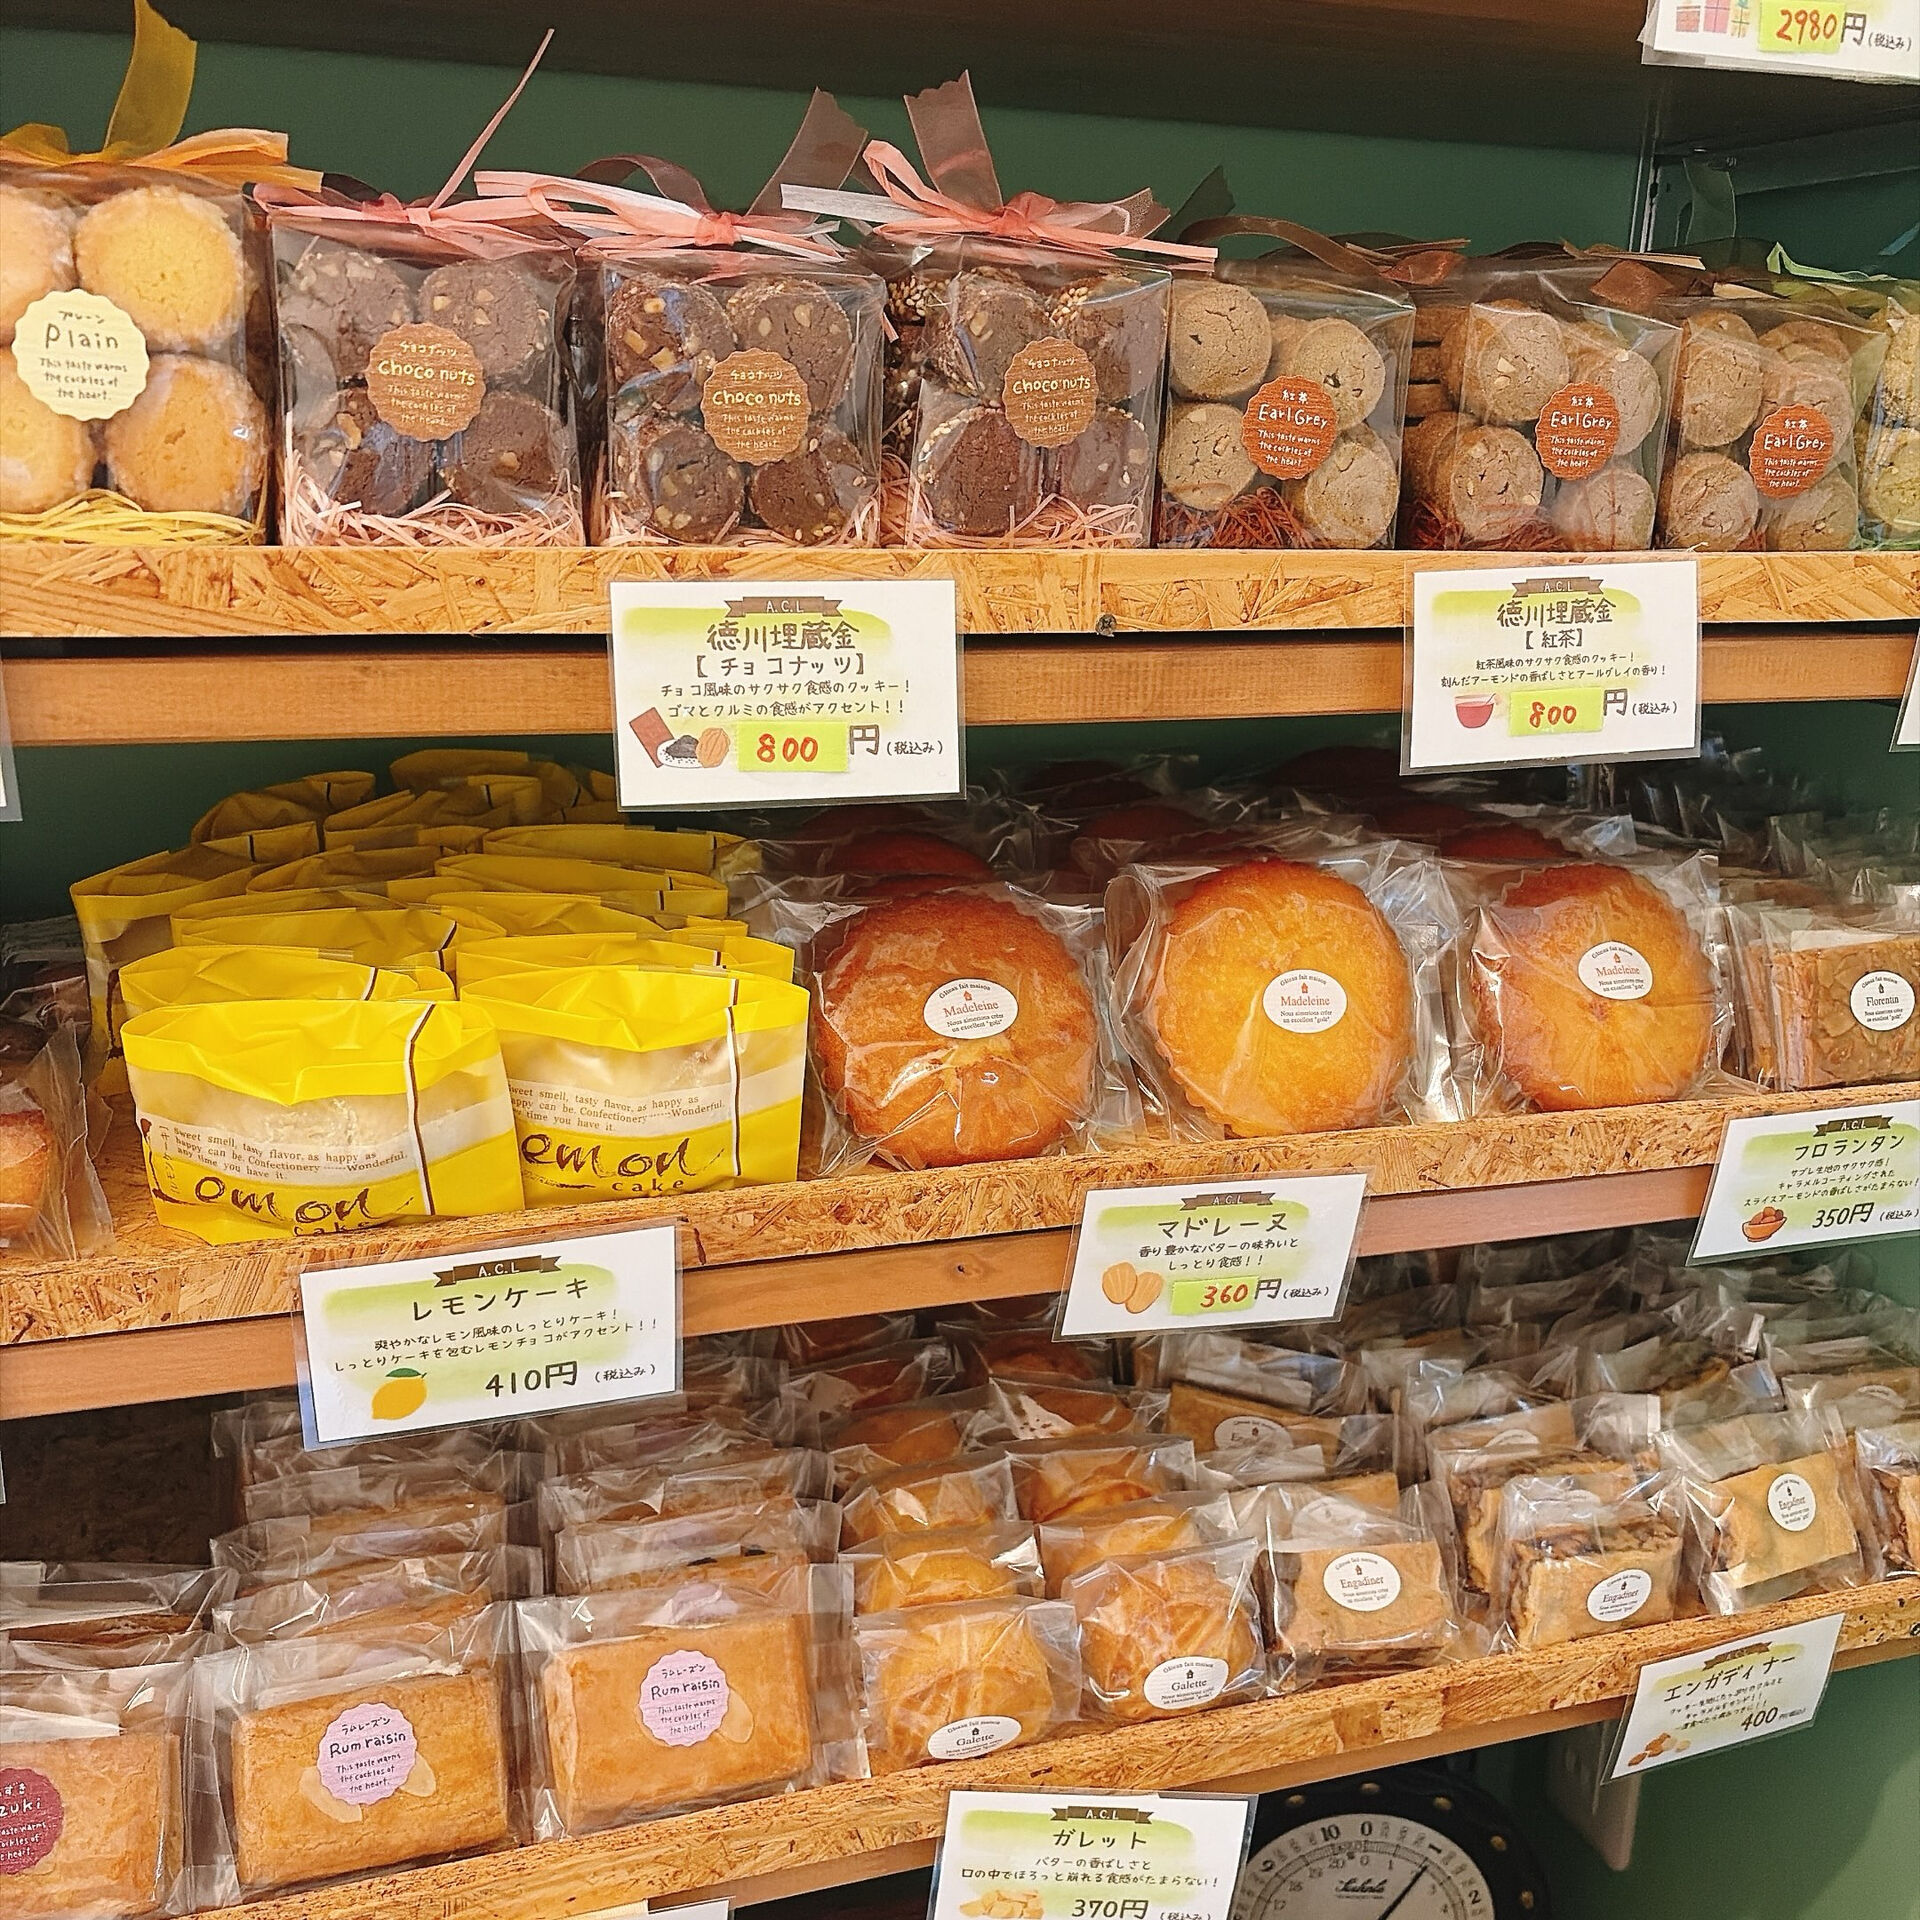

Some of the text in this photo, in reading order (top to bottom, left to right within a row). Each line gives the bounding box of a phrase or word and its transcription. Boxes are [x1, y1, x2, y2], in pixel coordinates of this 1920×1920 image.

[1776, 9, 1912, 52] 2980 円 (税込み)
[45, 323, 119, 349] Plain
[40, 357, 61, 368] This
[440, 368, 476, 386] nuts
[1063, 375, 1091, 389] nuts
[769, 389, 801, 406] nuts
[1282, 389, 1308, 404] 紅茶
[1571, 396, 1594, 408] 紅茶
[1784, 419, 1808, 430] 紅茶
[1543, 580, 1574, 593] A.C.L
[766, 600, 804, 613] A.C.L
[1497, 597, 1616, 628] 徳川埋蔵金
[706, 620, 860, 653] 徳川埋蔵金
[1529, 688, 1678, 728] 800 円 (税込み)
[756, 723, 944, 763] 800 円 (税込み)
[943, 1000, 999, 1018] Madeleine
[1281, 996, 1331, 1007] Madeleine
[511, 1098, 533, 1110] appy
[539, 1102, 556, 1110] can
[580, 1107, 648, 1124] Confectionery
[575, 1095, 599, 1108] tasty
[652, 1098, 682, 1109] happy
[688, 1096, 699, 1104] as
[526, 1111, 548, 1121] time
[554, 1116, 571, 1126] you
[577, 1117, 600, 1130] have
[175, 1136, 203, 1154] happy
[207, 1147, 226, 1157] can
[248, 1155, 321, 1173] Confectionery
[242, 1142, 264, 1157] tasty
[307, 1152, 320, 1161] as
[326, 1152, 359, 1165] happy
[365, 1152, 377, 1160] as
[521, 1133, 697, 1178] emon
[1794, 1134, 1905, 1161] フロランタン
[177, 1146, 195, 1159] any
[223, 1162, 241, 1174] you
[247, 1165, 270, 1179] have
[611, 1178, 684, 1192] cake
[1158, 1212, 1288, 1239] マドレーヌ
[478, 1261, 520, 1277] A.C.L
[412, 1277, 589, 1321] レモンケーキ
[1200, 1278, 1329, 1309] 360 円 (税込み)
[594, 1365, 656, 1382] (税込み)
[1171, 1680, 1207, 1691] Galette
[1664, 1656, 1796, 1702] エンガディナー
[651, 1679, 721, 1700] Rum raisin
[1741, 1707, 1779, 1732] 400
[329, 1732, 406, 1759] Rum raisin
[956, 1734, 995, 1746] Galette
[336, 1764, 353, 1775] This
[355, 1759, 375, 1770] taste
[0, 1782, 26, 1796] ずき
[1085, 1808, 1119, 1820] A.C.L
[0, 1827, 18, 1837] aste
[1052, 1828, 1148, 1850] ガレット
[1321, 1824, 1340, 1841] 10
[0, 1838, 28, 1848] ockles
[1469, 1889, 1482, 1905] 2
